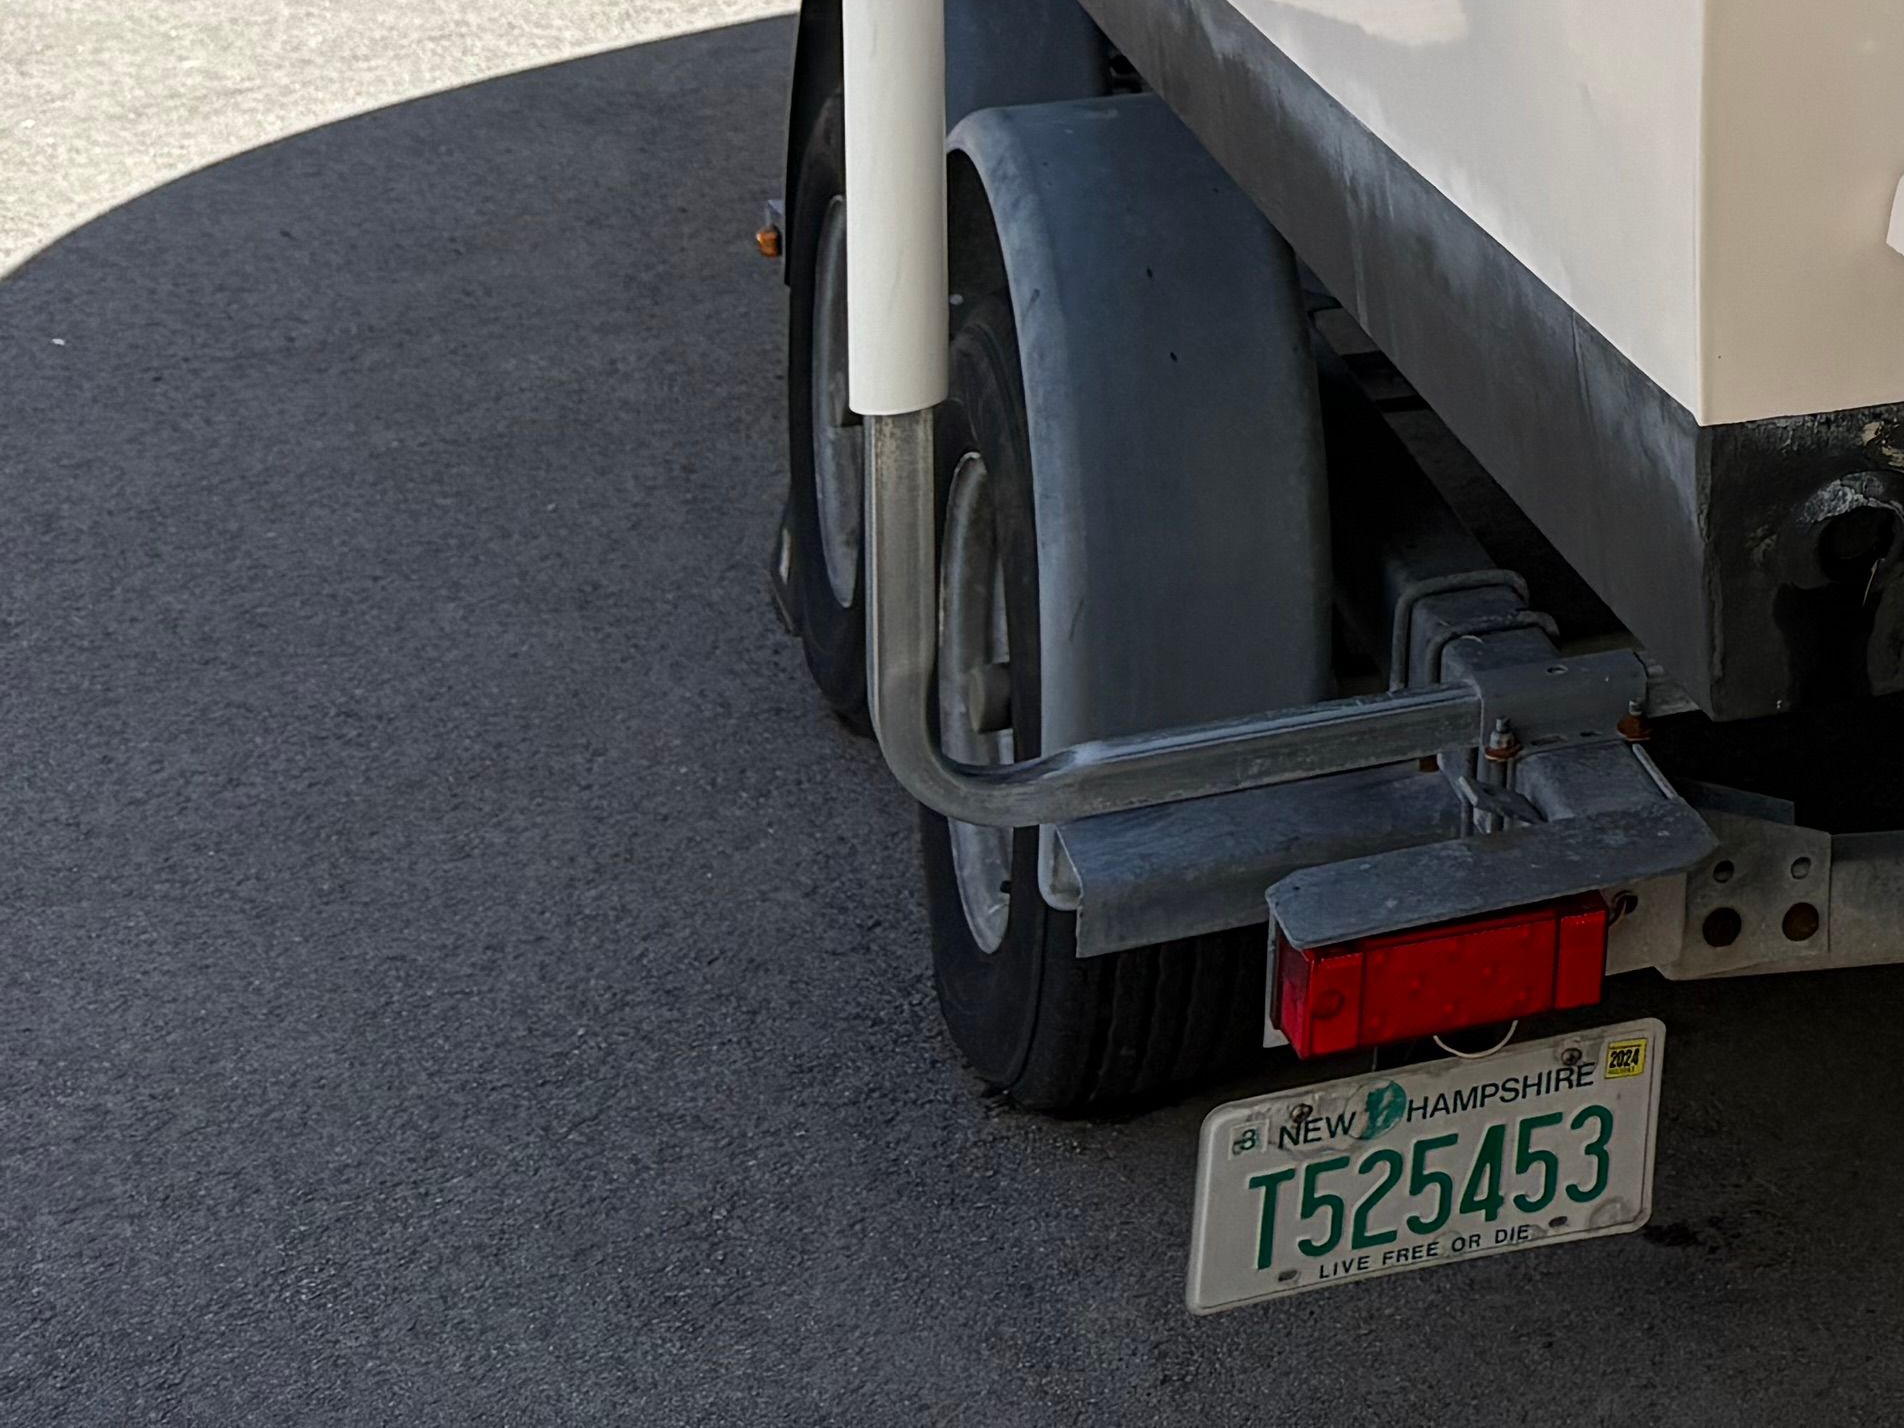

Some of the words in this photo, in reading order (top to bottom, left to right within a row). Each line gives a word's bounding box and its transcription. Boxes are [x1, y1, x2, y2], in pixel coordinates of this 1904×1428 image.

[1609, 1047, 1640, 1069] 2024
[1277, 1111, 1357, 1150] NEW
[1406, 1061, 1596, 1123] HAMPSHIRE
[1248, 1105, 1614, 1271] T525453
[1319, 1255, 1370, 1279] LIVE
[1382, 1241, 1440, 1266] FREE
[1451, 1233, 1482, 1253] OR
[1494, 1224, 1530, 1244] DIE
